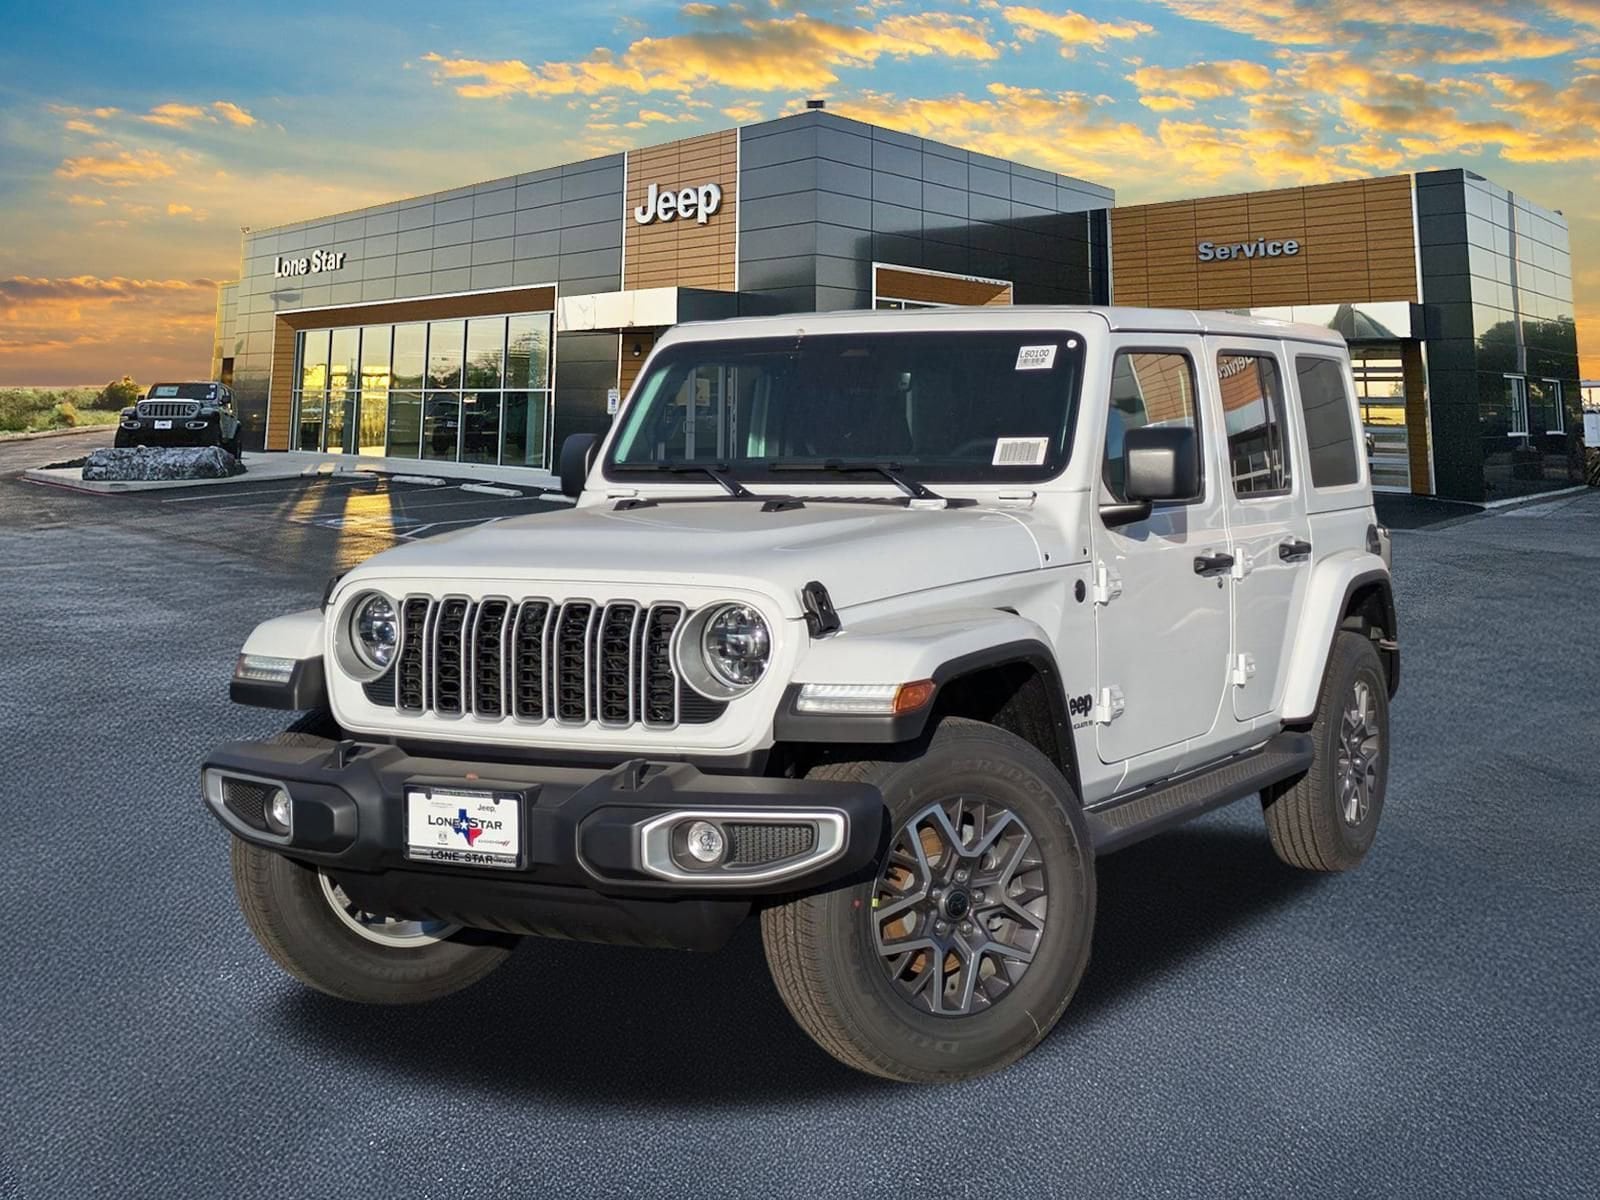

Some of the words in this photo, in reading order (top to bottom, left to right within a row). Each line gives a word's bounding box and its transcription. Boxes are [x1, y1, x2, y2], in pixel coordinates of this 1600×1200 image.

[634, 183, 722, 225] Jeep
[1198, 237, 1299, 261] Service
[275, 256, 310, 278] Lone
[311, 249, 346, 273] Star
[1067, 693, 1093, 717] eep
[477, 804, 496, 813] Jeep
[428, 815, 460, 828] LONE
[469, 817, 503, 830] STAR
[430, 850, 460, 861] LONE
[464, 853, 493, 864] STAR
